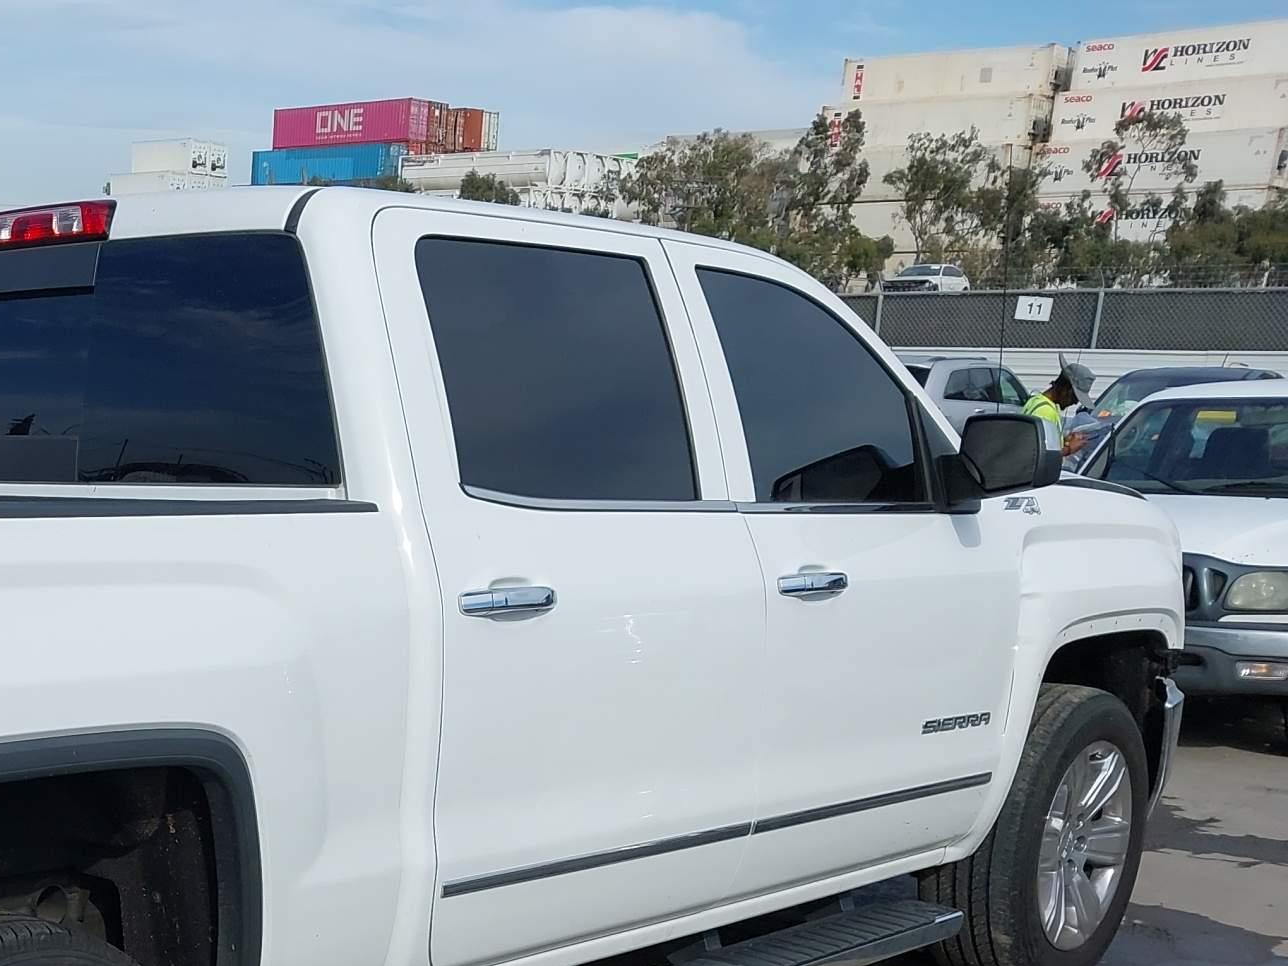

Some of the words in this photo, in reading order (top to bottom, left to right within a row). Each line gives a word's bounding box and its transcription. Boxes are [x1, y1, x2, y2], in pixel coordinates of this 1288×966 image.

[1086, 43, 1115, 52] seaco
[1171, 38, 1251, 58] HORIZON
[1170, 53, 1236, 66] LINES
[1064, 94, 1092, 103] seaco
[1149, 94, 1227, 111] HORIZON
[315, 107, 364, 133] ONE
[1126, 149, 1202, 164] HORIZON
[1027, 302, 1043, 315] 11
[921, 711, 991, 735] SIERRA
